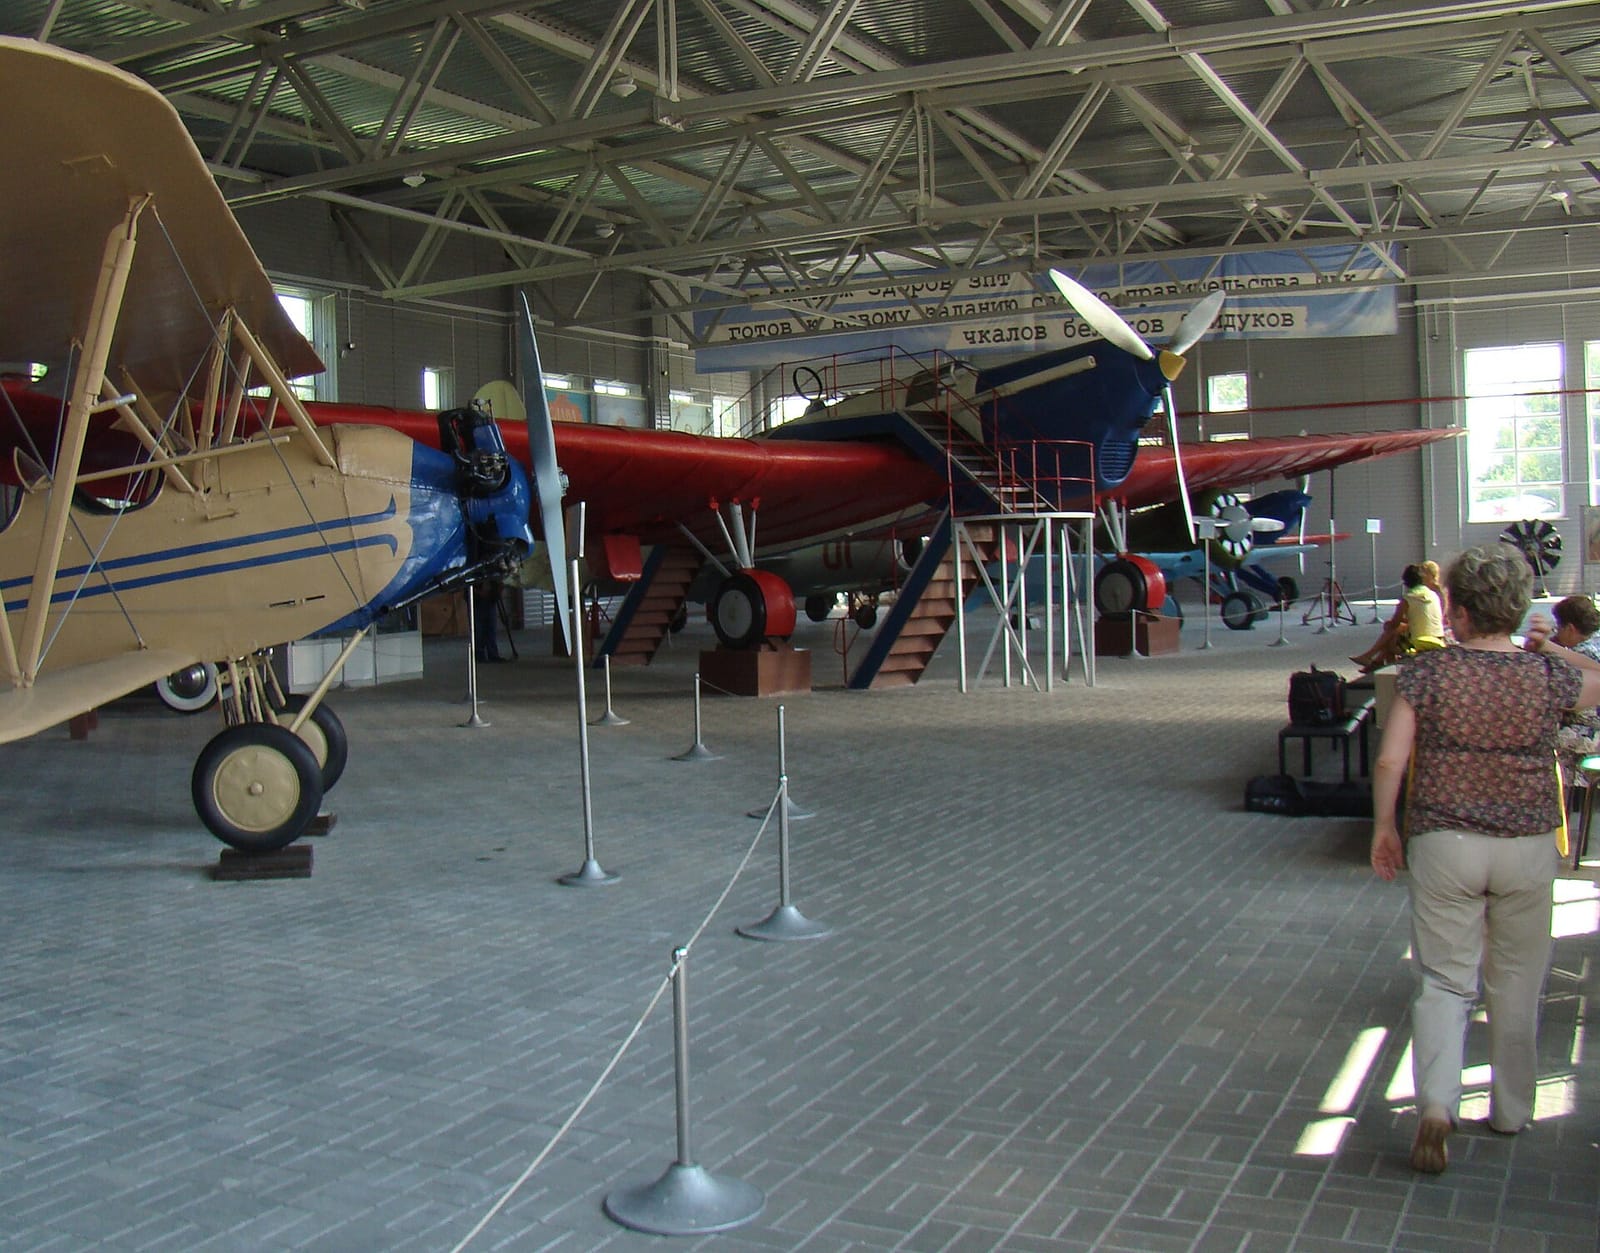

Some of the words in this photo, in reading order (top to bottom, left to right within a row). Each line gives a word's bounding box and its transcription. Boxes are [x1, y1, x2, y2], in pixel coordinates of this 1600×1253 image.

[969, 274, 1011, 288] зпт
[728, 322, 792, 340] готов
[963, 325, 1048, 344] чкалов
[1064, 318, 1164, 339] беов
[1181, 312, 1295, 333] йдуков
